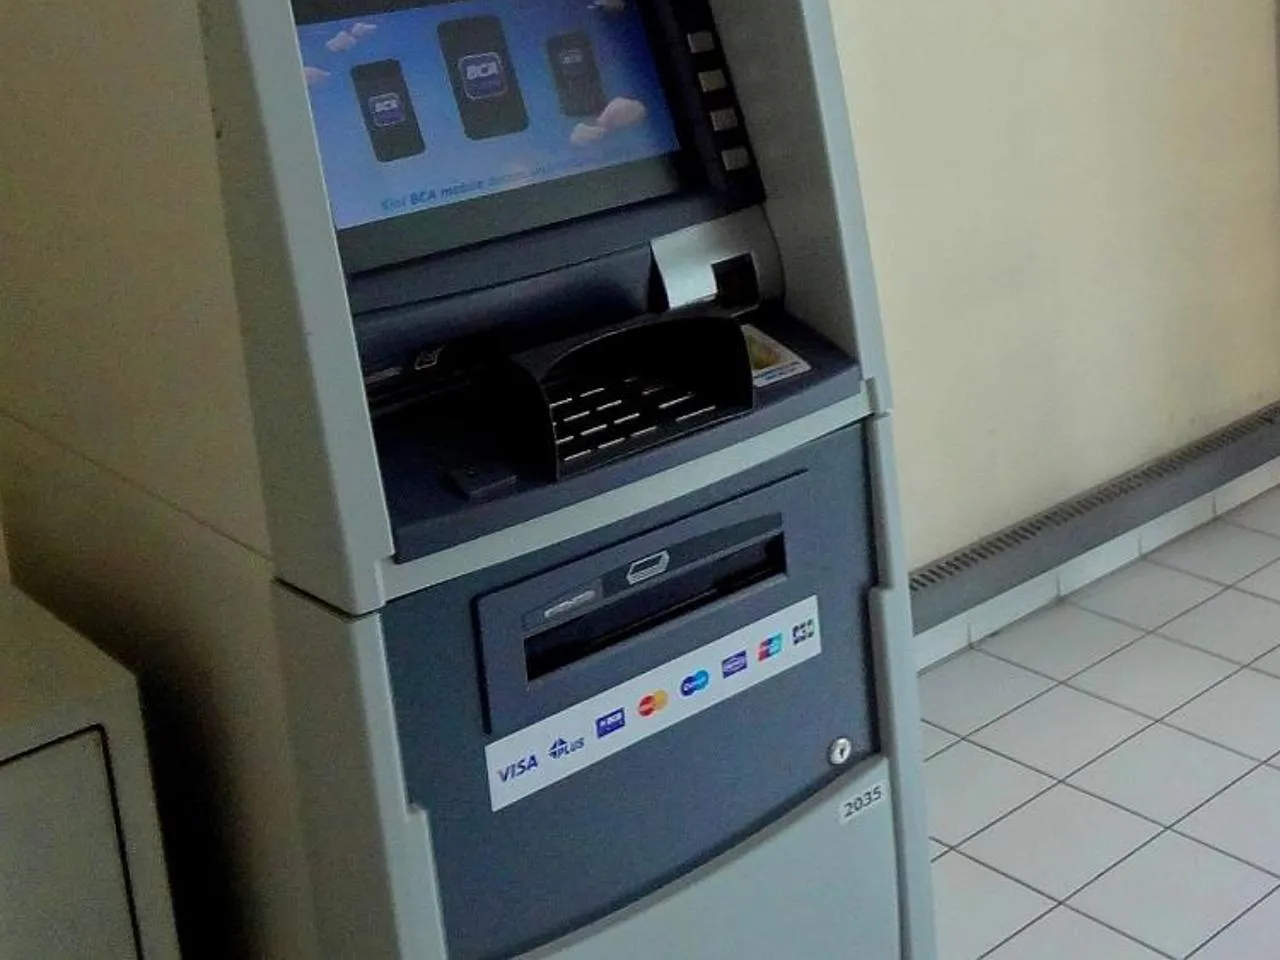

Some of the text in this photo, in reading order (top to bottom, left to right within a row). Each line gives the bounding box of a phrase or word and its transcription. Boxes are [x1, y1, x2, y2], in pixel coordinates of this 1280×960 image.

[465, 60, 498, 81] BCA
[497, 753, 539, 784] VISA
[842, 785, 883, 819] 2035
